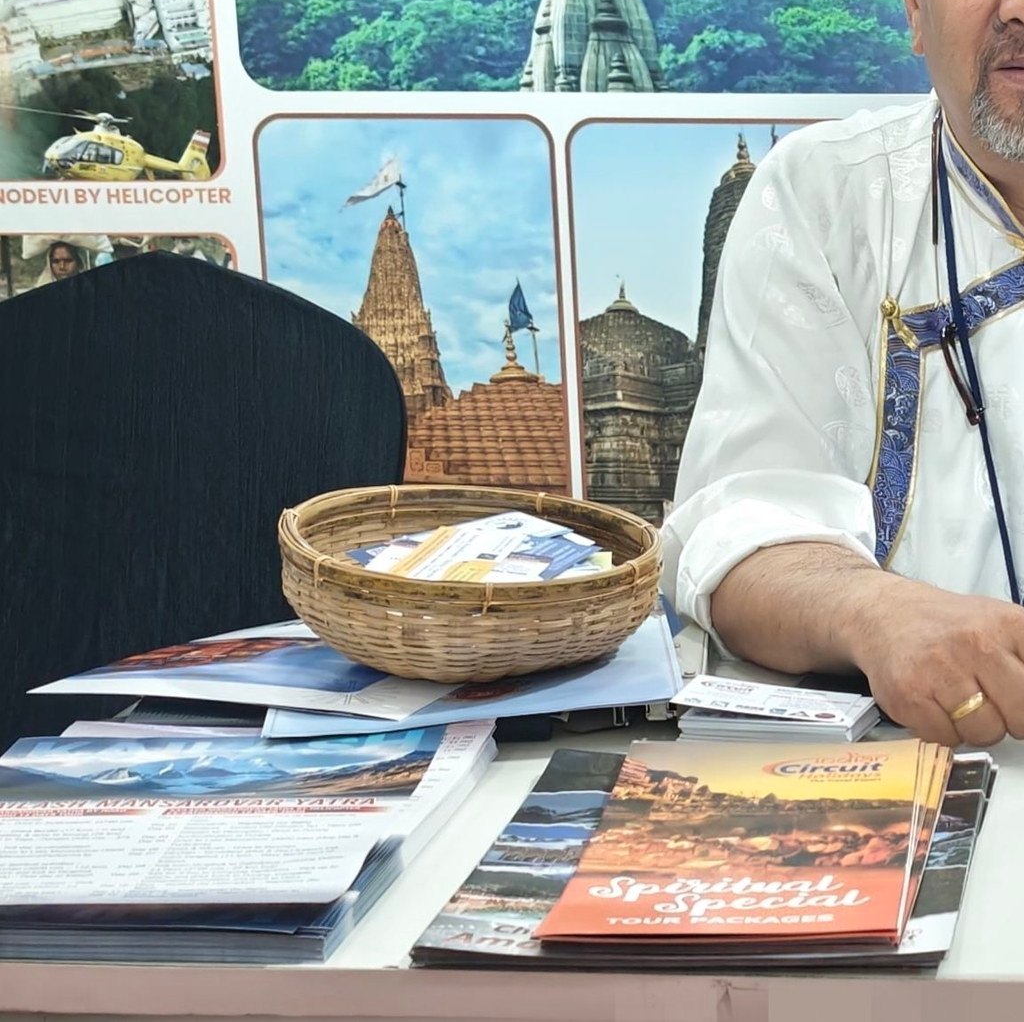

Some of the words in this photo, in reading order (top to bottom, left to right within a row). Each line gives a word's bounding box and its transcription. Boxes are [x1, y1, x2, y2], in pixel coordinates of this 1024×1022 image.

[75, 188, 101, 205] BY
[107, 187, 231, 204] HELICOPTER
[780, 762, 883, 774] Circuit
[97, 798, 285, 809] MANSAROVAR
[295, 797, 376, 807] YATRA
[588, 874, 846, 903] Spiritual
[653, 889, 871, 917] Special
[606, 917, 681, 925] TOUR
[689, 914, 835, 925] PACKAGES
